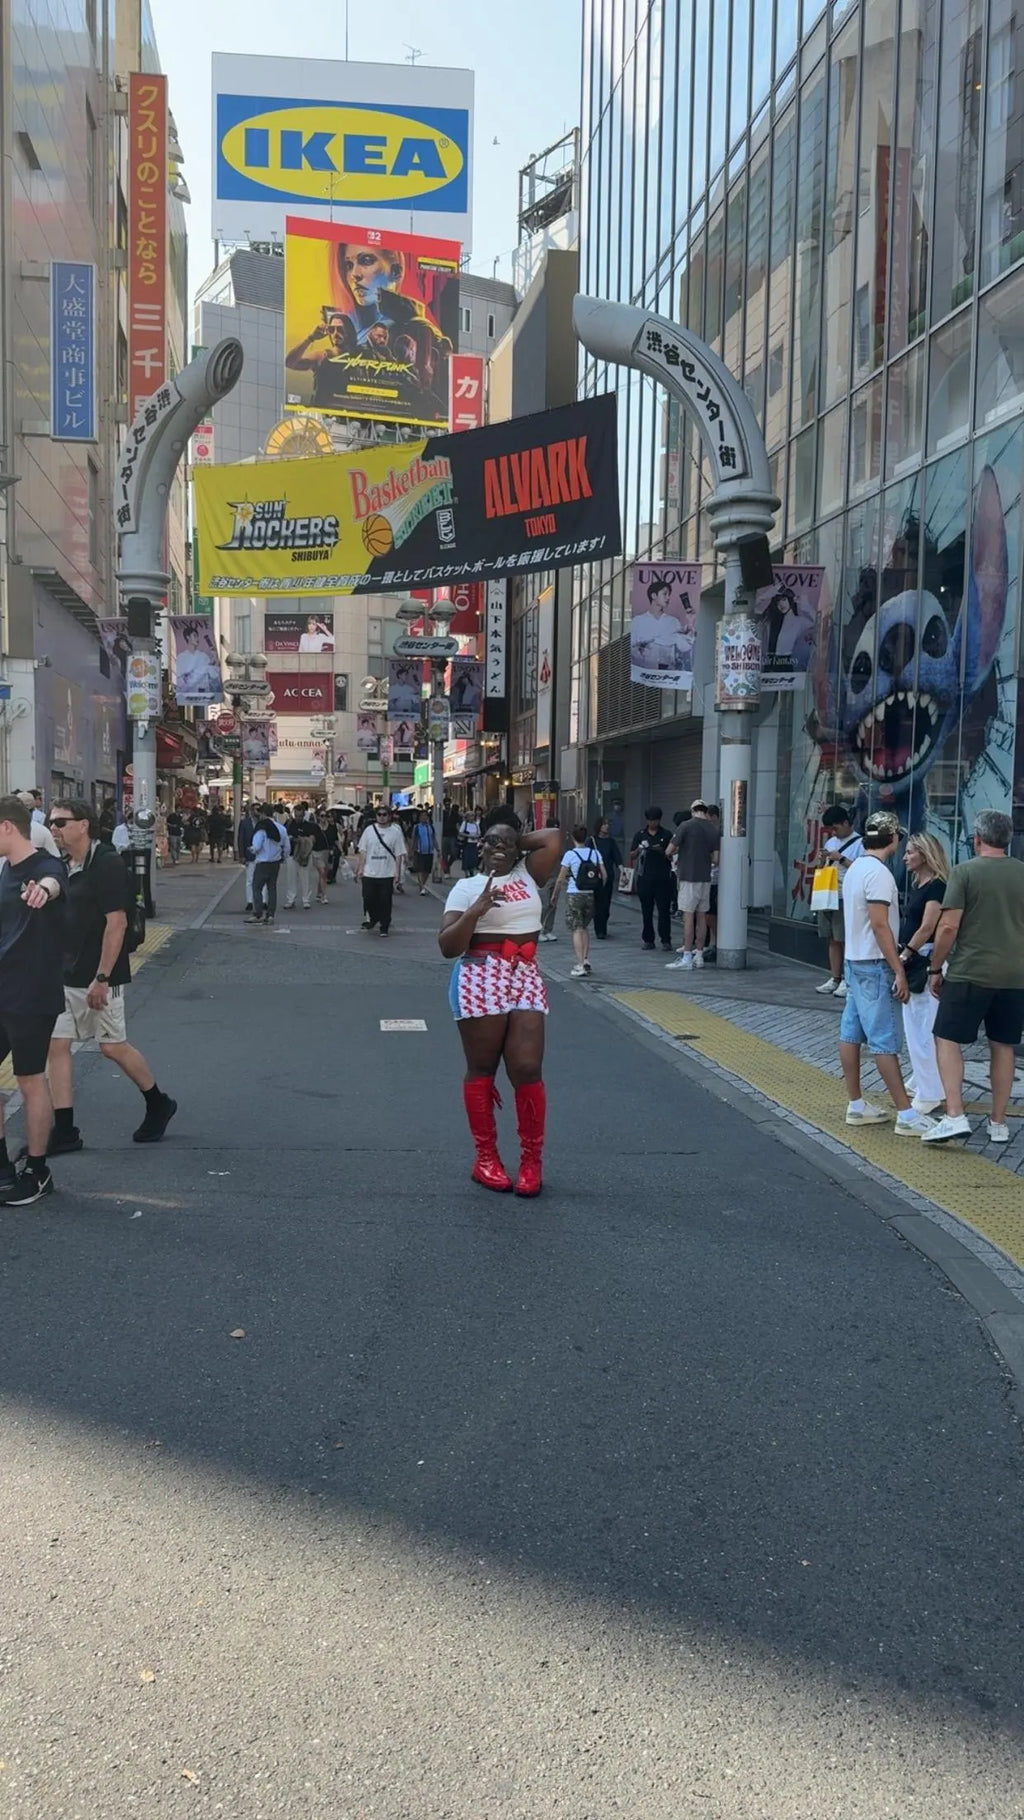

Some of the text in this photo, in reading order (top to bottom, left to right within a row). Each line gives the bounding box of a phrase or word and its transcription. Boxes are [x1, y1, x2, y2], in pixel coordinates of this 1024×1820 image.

[244, 127, 448, 179] IKEA
[135, 84, 161, 286] クスリのことなら
[62, 272, 87, 431] 大盛堂商事ビル
[646, 330, 737, 470] 渋谷センター街
[116, 388, 171, 527] 渋谷センター街
[484, 435, 593, 519] ALVARK
[254, 499, 286, 519] SUN
[348, 456, 451, 521] Basketball
[216, 500, 341, 550] ROCKERS
[524, 513, 557, 539] TOKYO
[291, 550, 330, 562] SHIBUYA
[638, 570, 697, 586] UNOVE
[774, 573, 820, 588] NOVE
